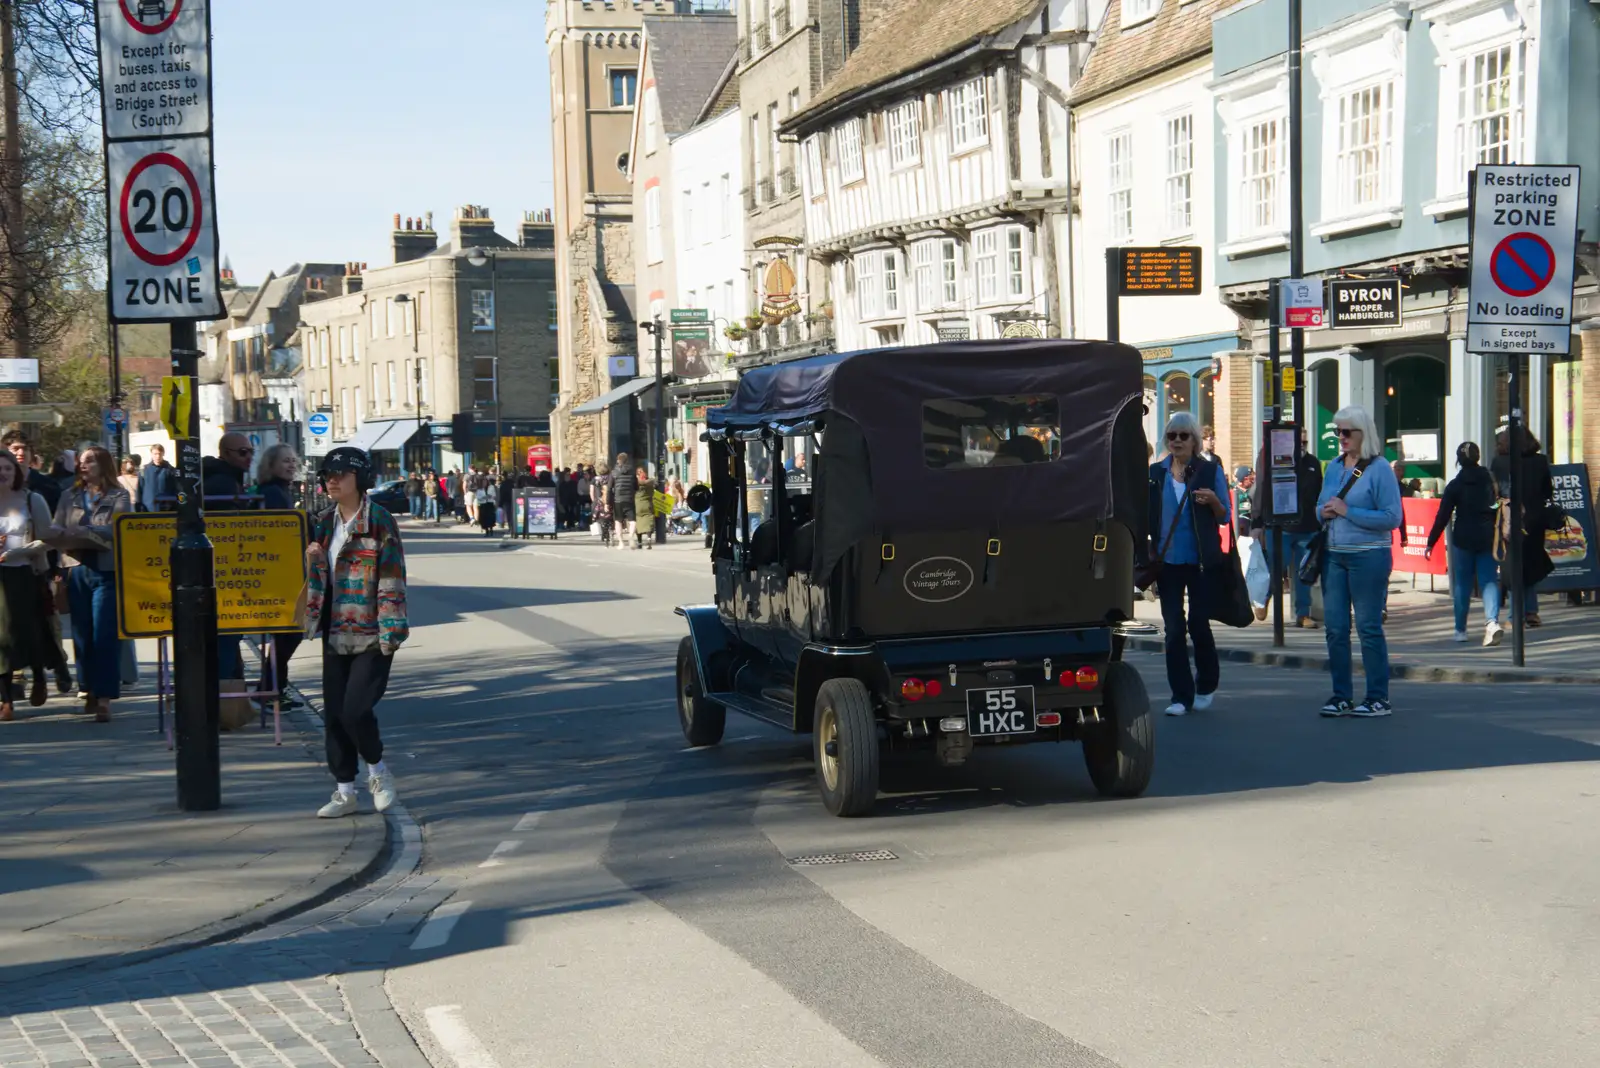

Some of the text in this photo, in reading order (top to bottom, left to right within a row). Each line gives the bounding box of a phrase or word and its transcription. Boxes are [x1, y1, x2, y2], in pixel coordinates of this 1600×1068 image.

[122, 42, 187, 59] Except for
[161, 59, 191, 73] taxis
[114, 76, 198, 94] and access to
[115, 93, 199, 111] Bridge Street
[132, 111, 183, 129] (South)
[1485, 172, 1571, 187] Restricted
[1495, 192, 1558, 207] parking
[132, 187, 188, 233] 20
[1493, 209, 1556, 226] ZONE
[125, 277, 203, 305] ZONE
[1339, 288, 1392, 303] BYRON
[1350, 304, 1382, 312] PROPER
[1476, 302, 1565, 319] No loading
[1338, 312, 1395, 321] HAMBURGERS
[1501, 328, 1537, 338] Except
[1480, 338, 1556, 350] in signed bays
[1561, 500, 1585, 510] HERE
[229, 519, 298, 529] notification
[239, 534, 266, 543] here
[145, 556, 164, 567] 23
[237, 552, 252, 563] 27
[257, 552, 281, 562] Mar
[231, 567, 267, 577] Water
[919, 568, 957, 580] Cambridge
[912, 578, 961, 590] Vintage Tours
[137, 601, 157, 611] We
[222, 599, 233, 607] in
[236, 597, 287, 607] advance
[147, 614, 166, 624] for
[985, 689, 1016, 711] 55
[979, 711, 1025, 734] HXC
